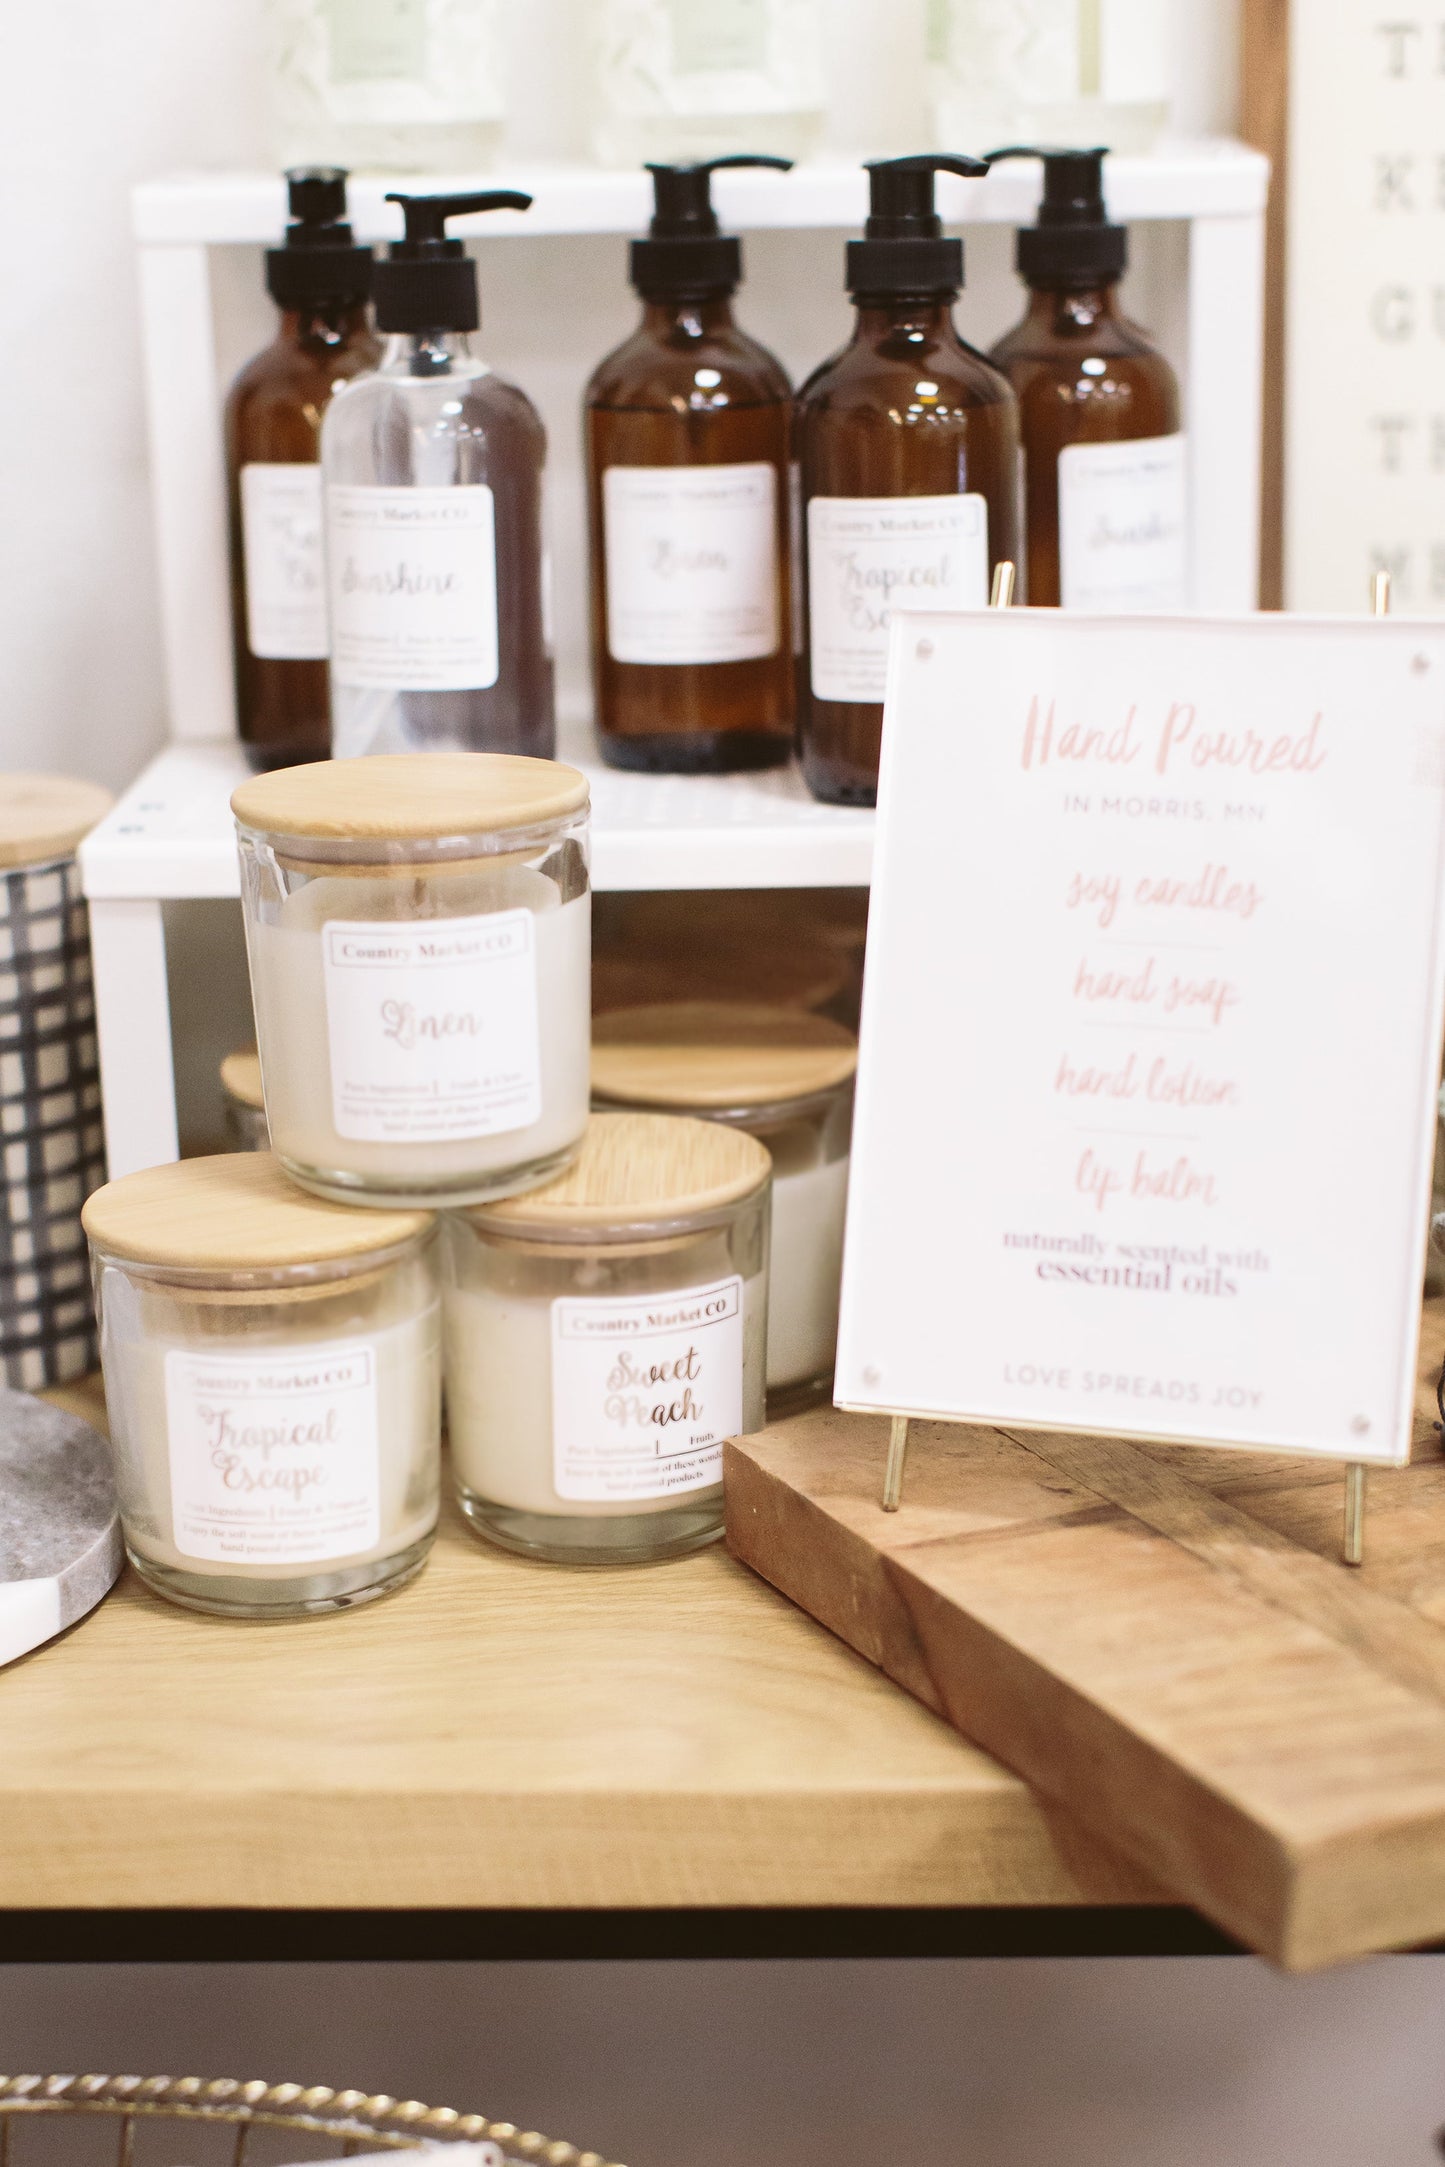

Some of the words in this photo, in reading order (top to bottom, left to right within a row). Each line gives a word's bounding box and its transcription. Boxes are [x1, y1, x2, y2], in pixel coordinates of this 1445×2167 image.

[830, 551, 952, 601] Tropical
[841, 594, 892, 633] Esc
[1020, 694, 1142, 772] Hand
[1155, 700, 1329, 775] Poured
[1063, 794, 1091, 814] IN
[1224, 804, 1267, 823] MN
[1065, 871, 1124, 929] soy
[1135, 862, 1266, 919] candles
[342, 942, 411, 962] Country
[418, 939, 481, 957] Market
[1073, 956, 1159, 1003] hand
[1164, 975, 1243, 1026] soap
[380, 999, 482, 1051] Linen
[1053, 1052, 1140, 1099] hand
[1144, 1056, 1240, 1108] lotion
[1074, 1146, 1123, 1213] lip
[1130, 1149, 1220, 1208] balm
[1002, 1230, 1107, 1259] naturally
[1115, 1241, 1208, 1268] scented
[1215, 1248, 1271, 1273] with
[1035, 1260, 1173, 1293] essential
[1182, 1266, 1239, 1298] oils
[572, 1316, 640, 1334] Country
[646, 1308, 701, 1328] Market
[705, 1298, 727, 1317] CO
[256, 1375, 319, 1390] Market
[606, 1345, 702, 1392] Sweet
[1002, 1362, 1073, 1392] LOVE
[1080, 1369, 1201, 1407] SPREADS
[1210, 1385, 1268, 1409] JOY
[603, 1387, 705, 1429] Peach
[196, 1404, 342, 1461] Tropical
[689, 1433, 715, 1446] Fruits
[210, 1449, 328, 1502] Escape
[666, 1470, 704, 1487] products
